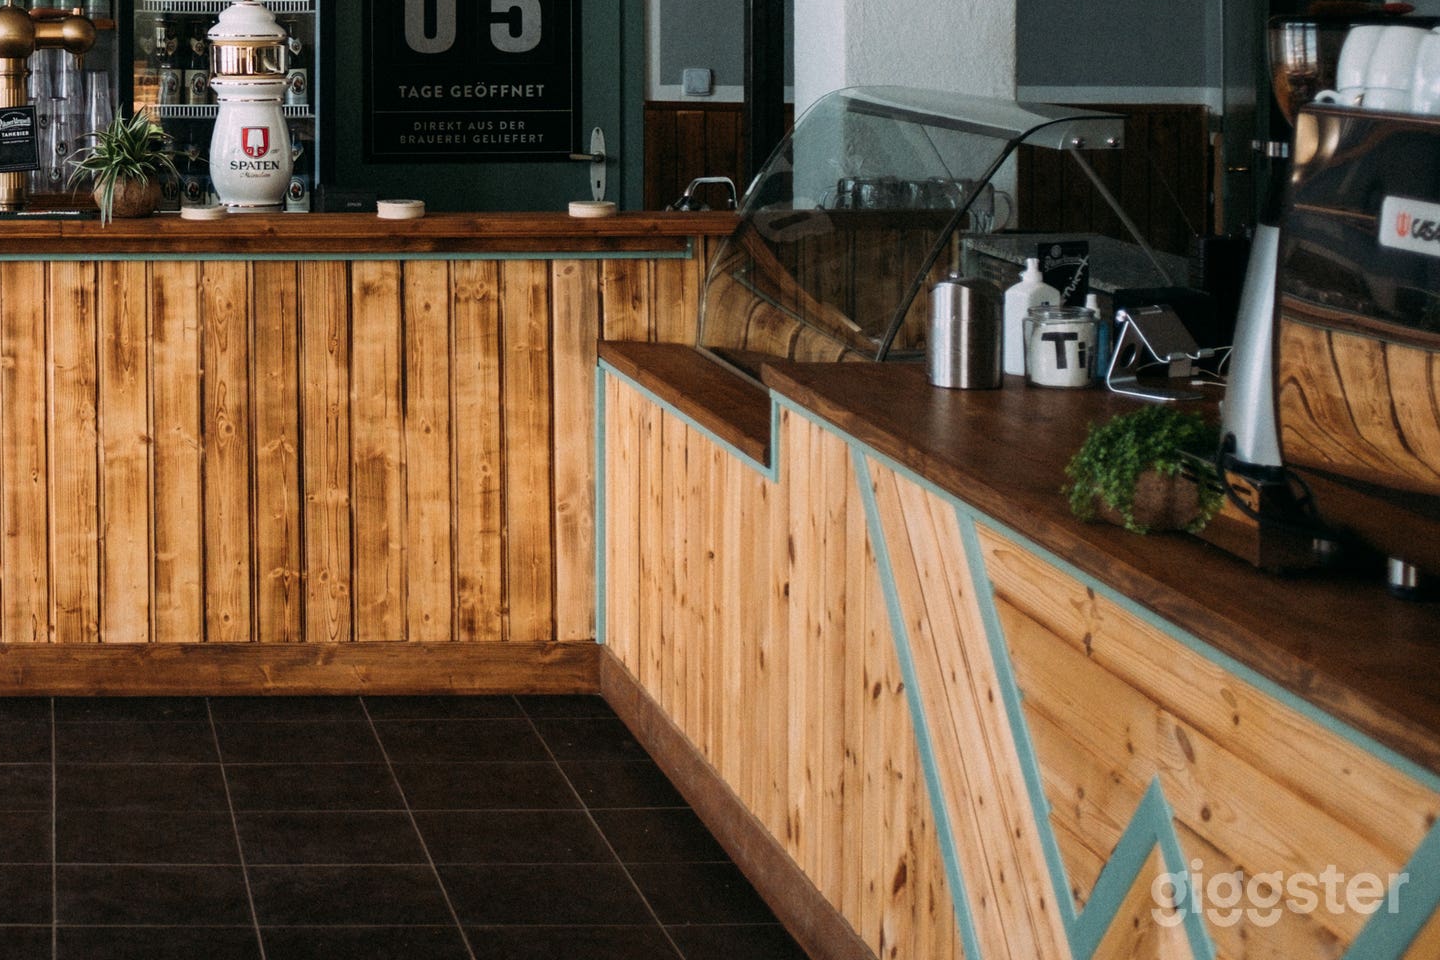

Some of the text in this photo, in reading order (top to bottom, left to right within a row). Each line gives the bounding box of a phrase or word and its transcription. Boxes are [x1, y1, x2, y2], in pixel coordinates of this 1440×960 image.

[399, 82, 545, 98] TAGE GEÖFFNET
[413, 121, 525, 131] DIREKT AUS DER
[400, 134, 544, 144] BRAUEREI GELIEFERT
[230, 160, 280, 171] SPATEN
